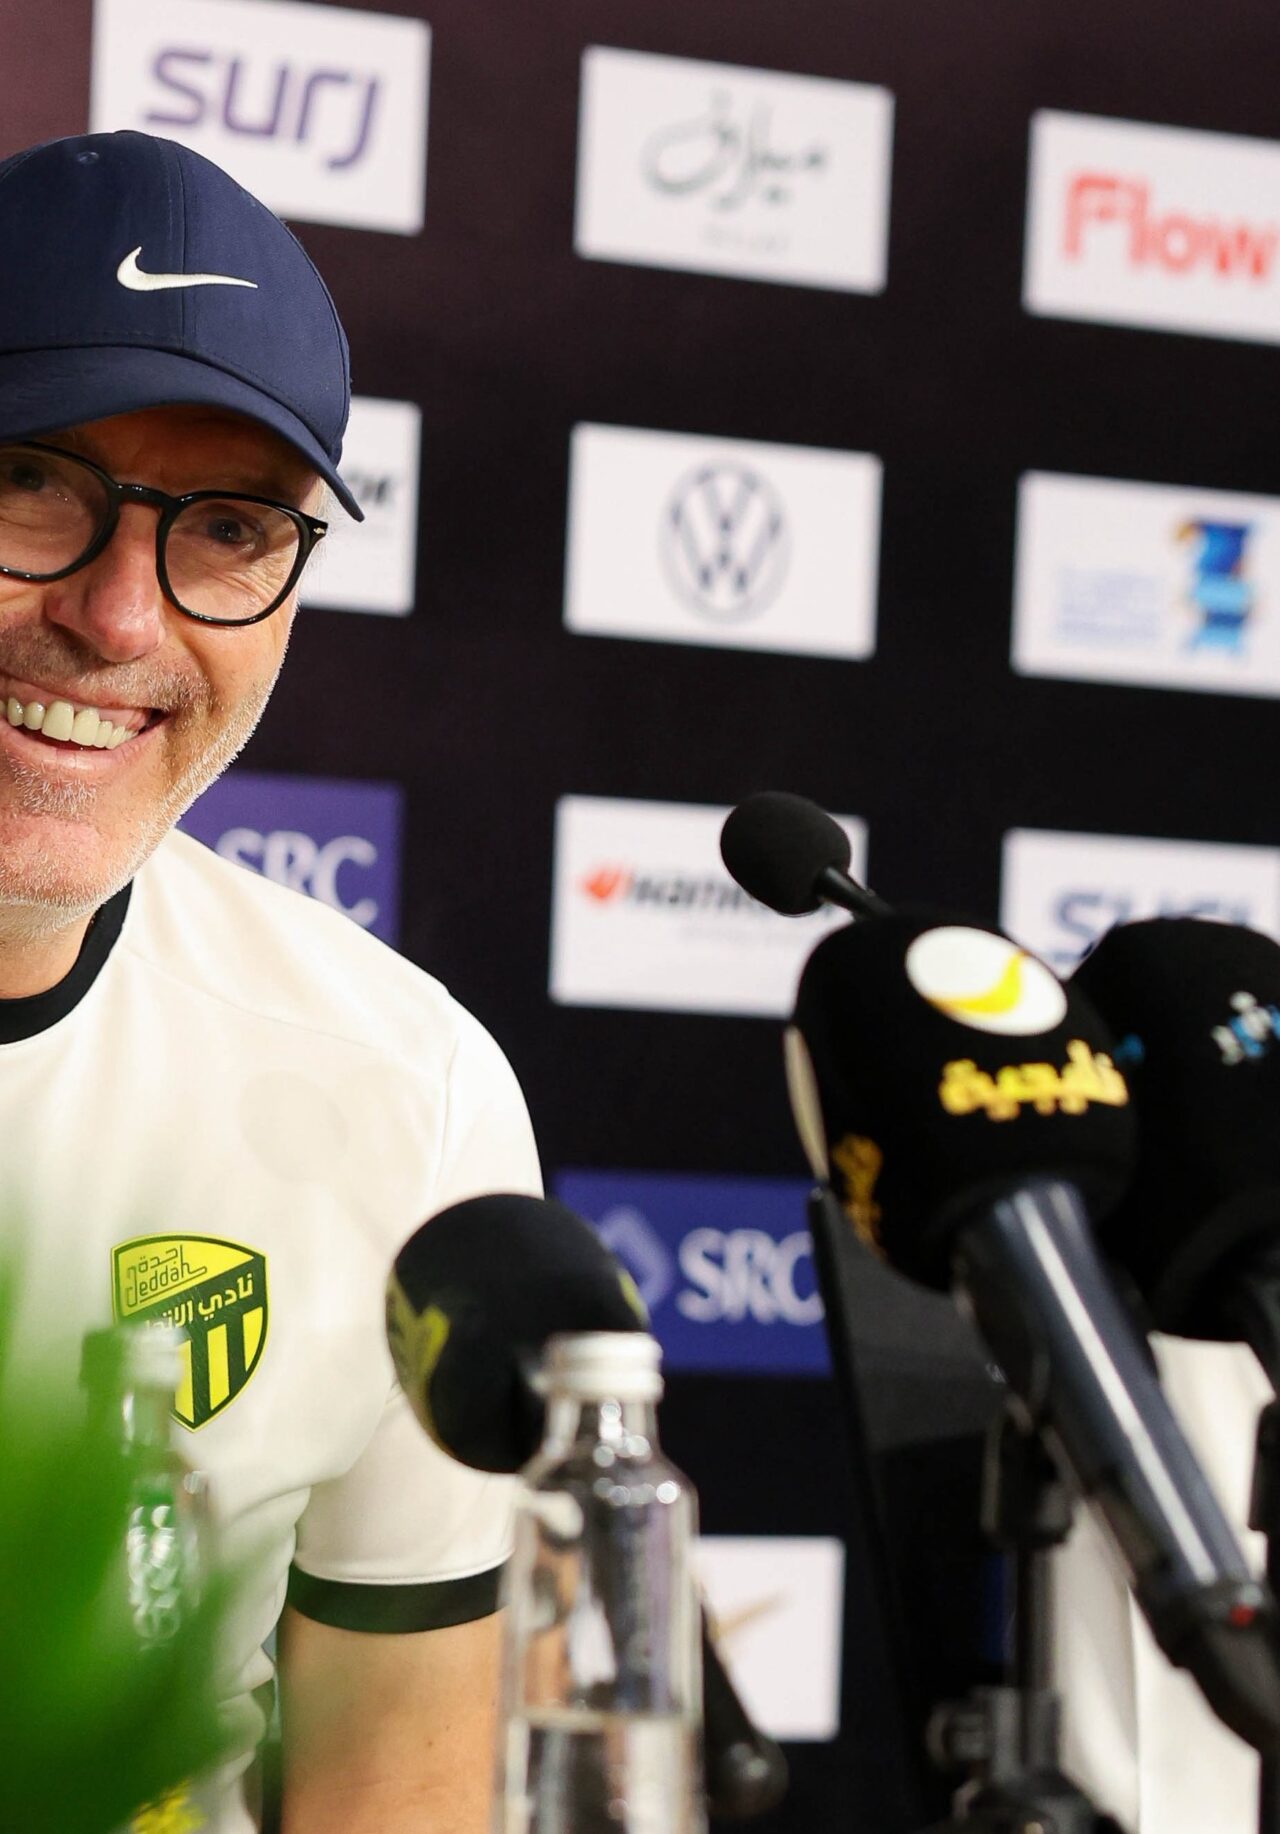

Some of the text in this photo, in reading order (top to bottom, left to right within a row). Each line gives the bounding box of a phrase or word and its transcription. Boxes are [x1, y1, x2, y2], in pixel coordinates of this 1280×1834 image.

[1062, 172, 1279, 281] Flow
[198, 1272, 254, 1321] نادي
[678, 1228, 827, 1326] SRC
